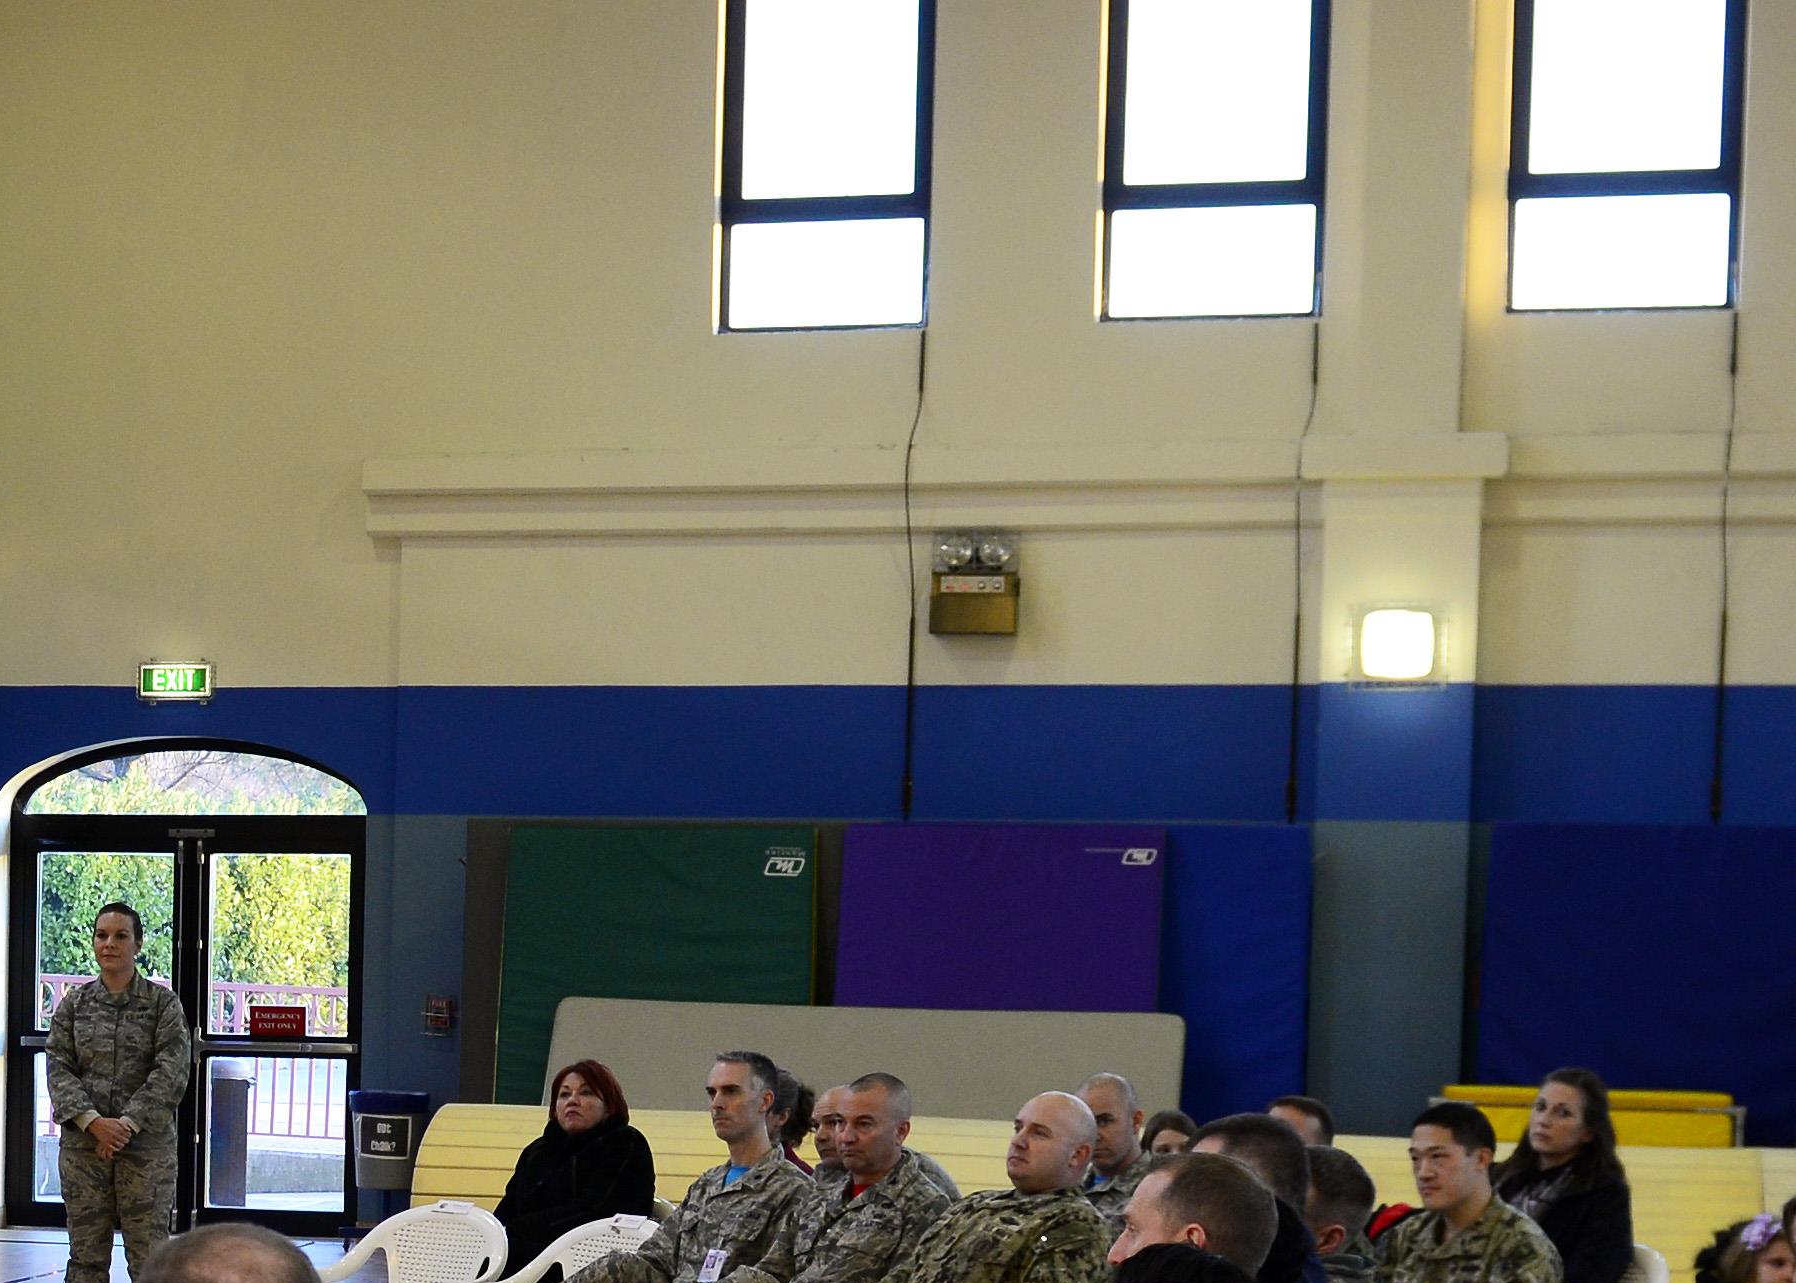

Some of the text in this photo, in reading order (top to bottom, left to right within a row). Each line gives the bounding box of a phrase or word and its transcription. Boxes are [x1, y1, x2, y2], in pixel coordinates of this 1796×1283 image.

[152, 669, 196, 691] EXIT
[255, 1011, 301, 1020] EMERGENCY
[258, 1022, 297, 1030] EXIT ONLY
